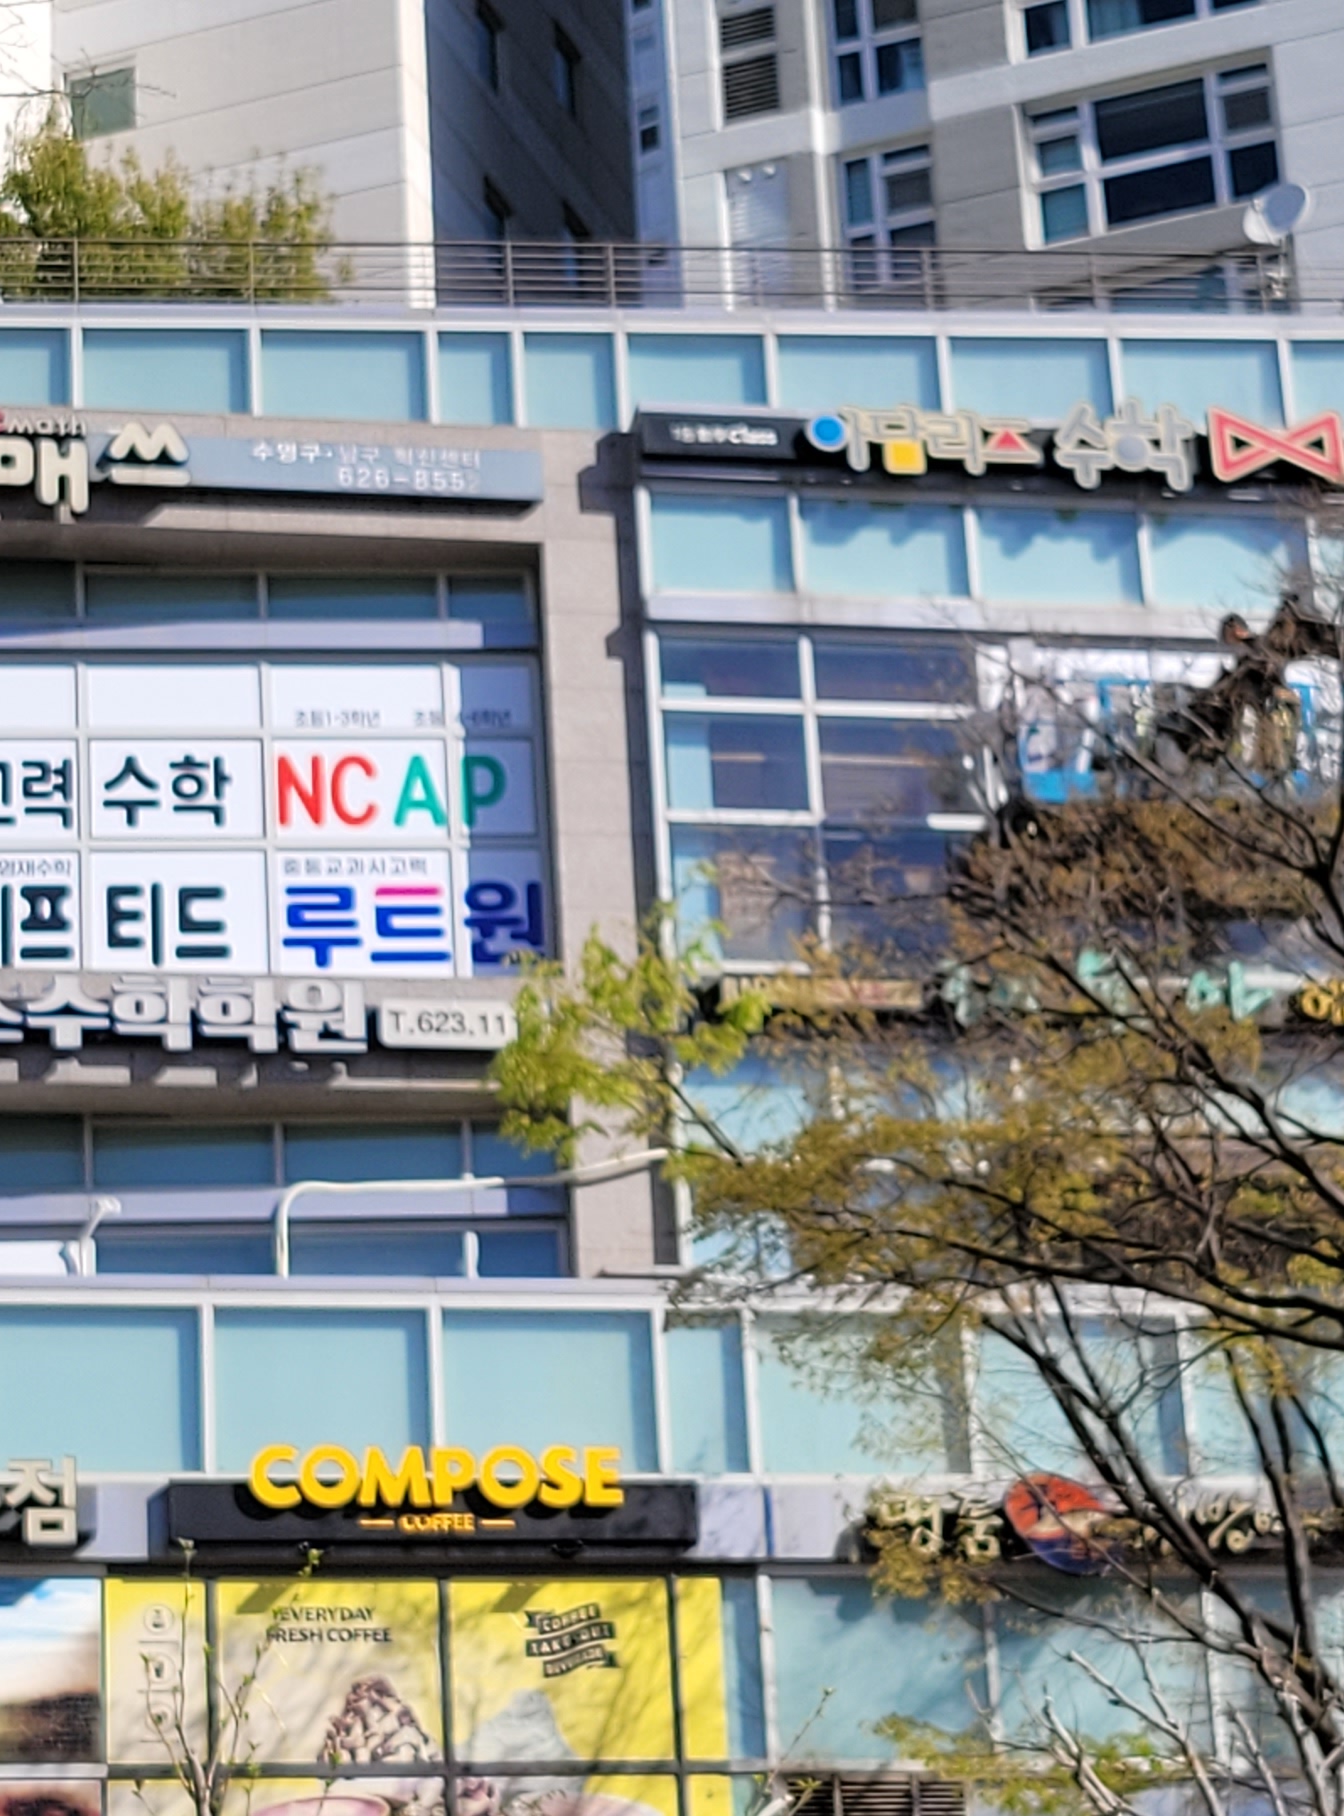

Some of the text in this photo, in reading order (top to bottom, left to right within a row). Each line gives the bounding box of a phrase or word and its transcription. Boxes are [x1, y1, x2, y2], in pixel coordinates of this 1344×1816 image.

[1054, 403, 1196, 492] 수학
[103, 755, 233, 828] 수학
[282, 880, 550, 970] 루트원
[249, 1445, 624, 1510] COMPOSE
[400, 1513, 475, 1534] COFFEE
[266, 1628, 394, 1643] FRESH COFFEE
[279, 1607, 375, 1622] EVERYDAY
